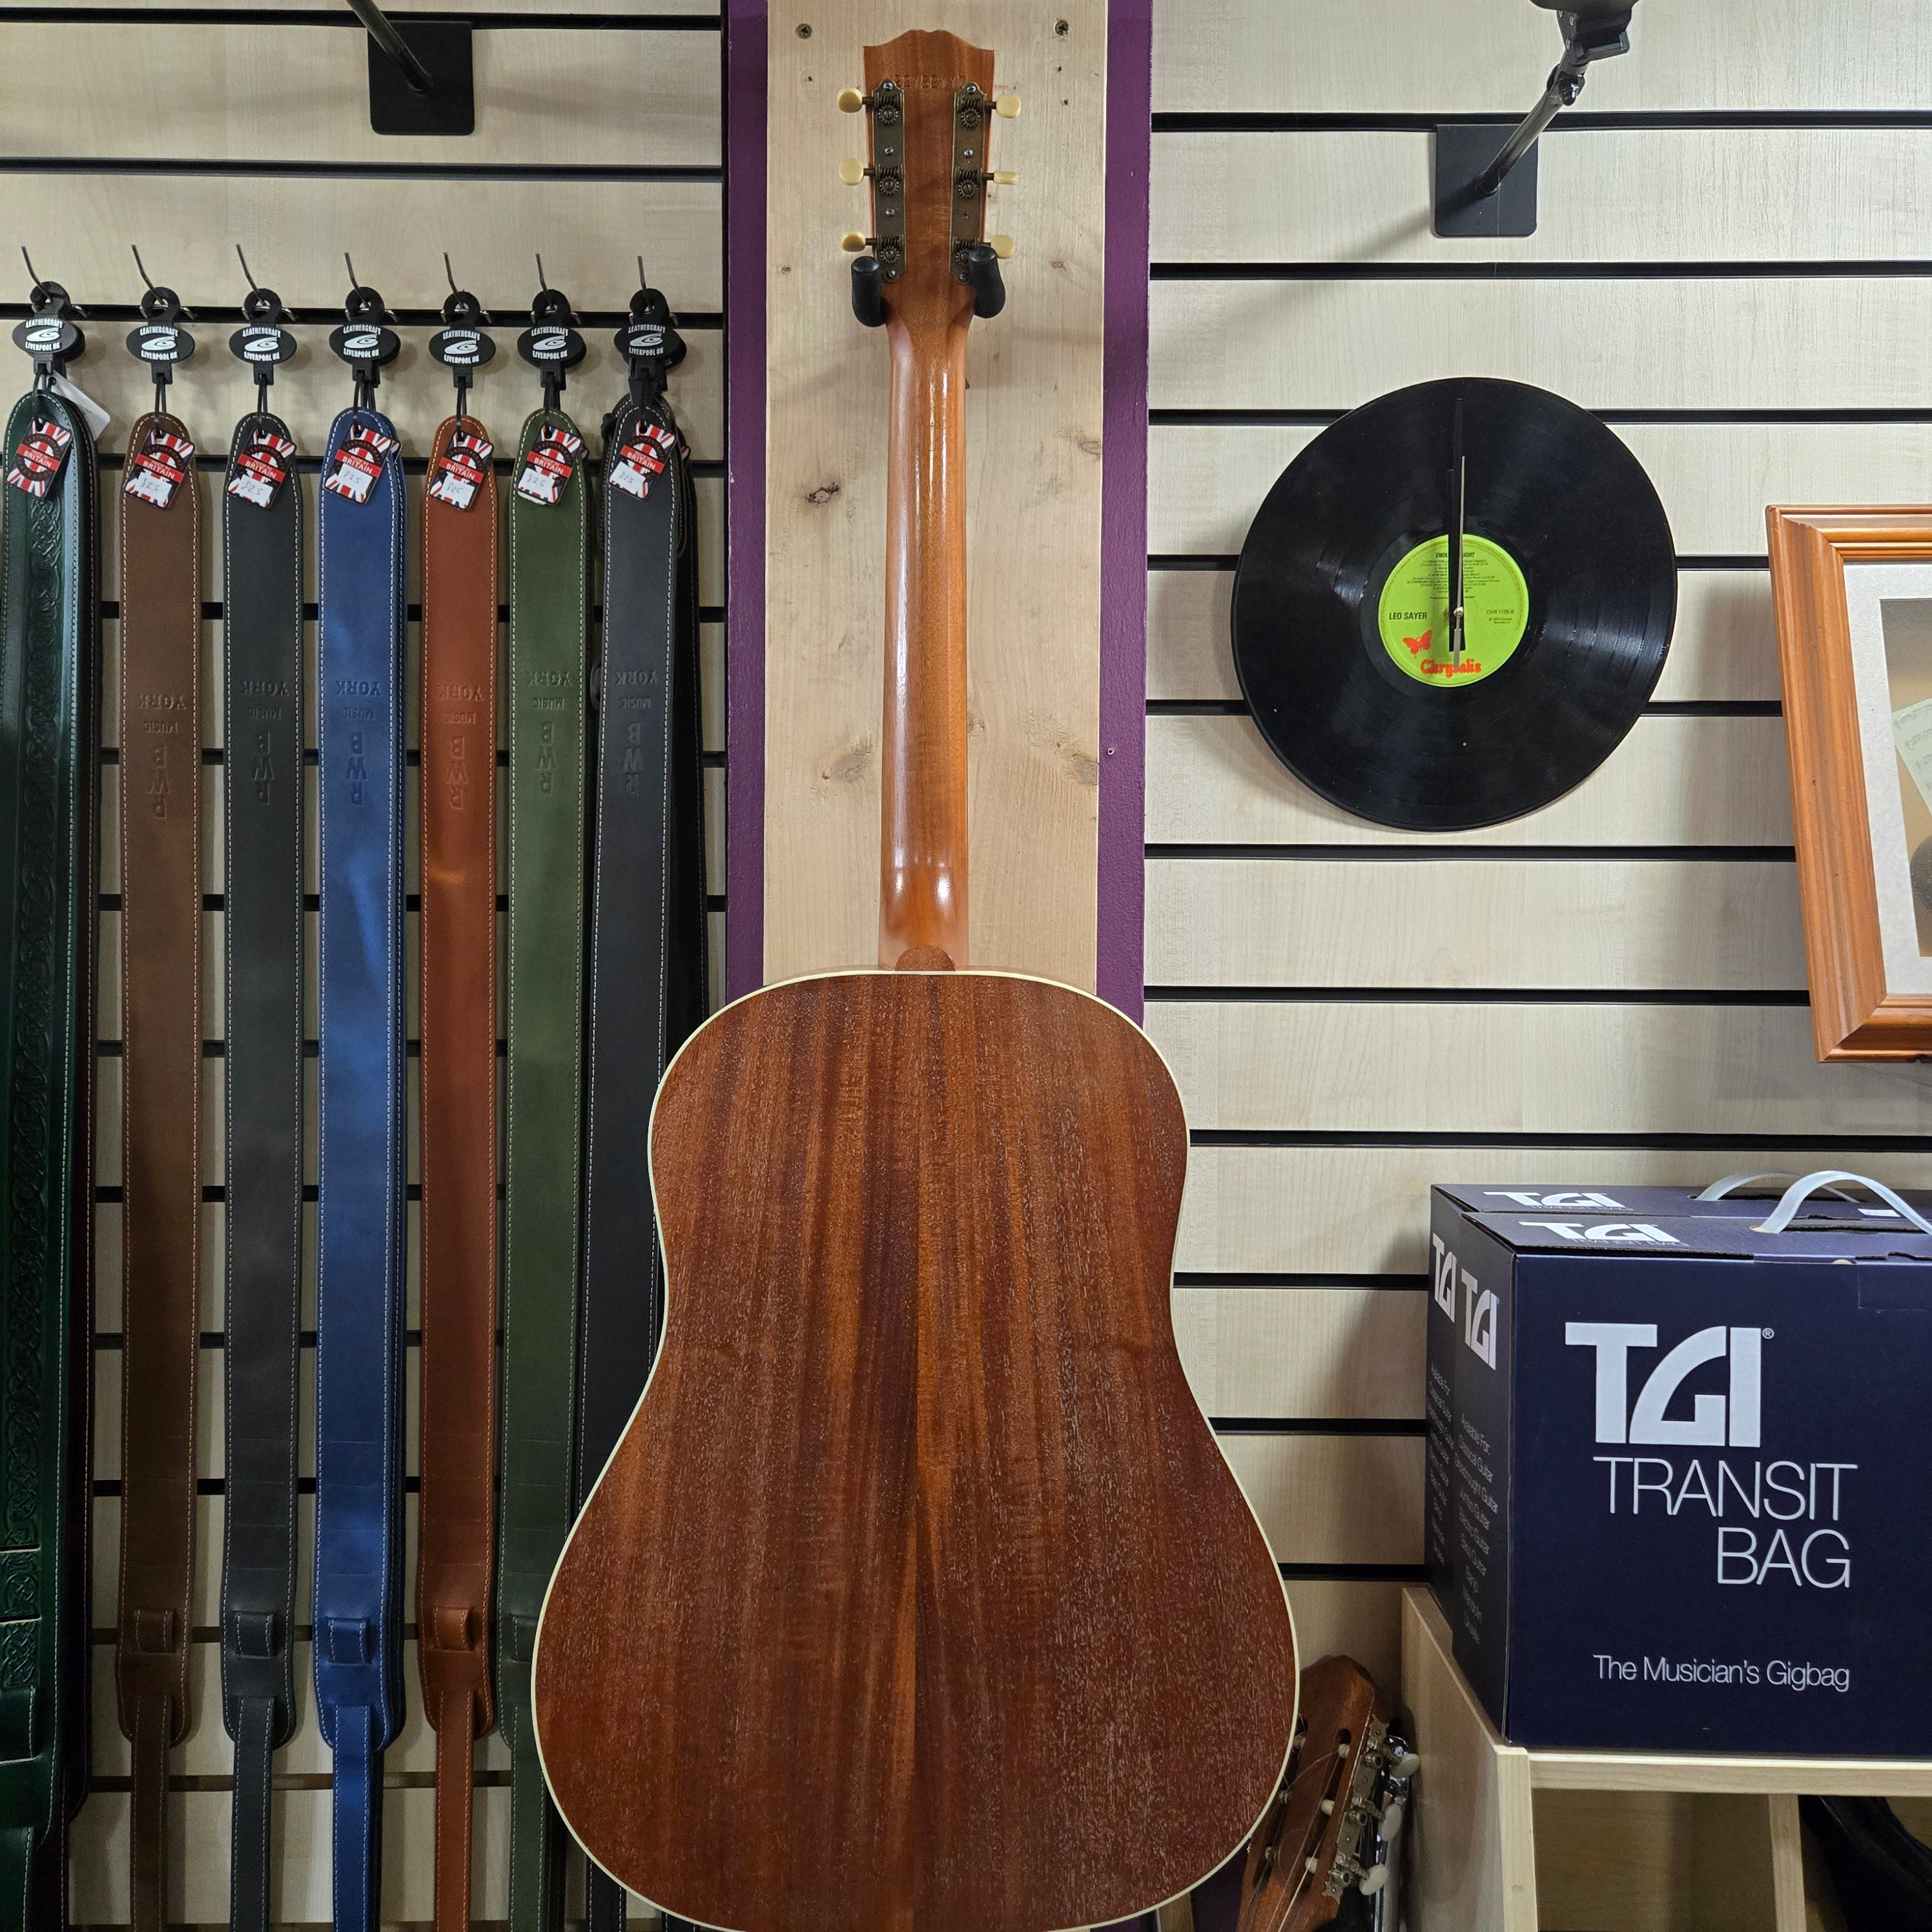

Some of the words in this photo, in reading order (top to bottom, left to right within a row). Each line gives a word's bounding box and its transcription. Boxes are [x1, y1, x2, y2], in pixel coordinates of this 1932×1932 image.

[26, 319, 63, 329] LEATHERCRAFT
[140, 326, 178, 337] LEATHERCRAFT
[343, 324, 381, 335] LEATHERCRAFT
[531, 326, 568, 336] LEATHERCRAFT
[628, 324, 666, 334] LEATHERCRAFT
[243, 327, 281, 338] LEATHERCRAFT
[442, 330, 480, 341] LEATHERCRAFT
[25, 342, 52, 351] LIVERPOOL
[344, 348, 371, 358] LIVERPOOL
[629, 347, 656, 356] LIVERPOOL
[141, 351, 169, 360] LIVERPOOL
[244, 351, 272, 362] LIVERPOOL
[444, 355, 471, 364] LIVERPOOL
[532, 350, 560, 360] LIVERPOOL
[23, 450, 52, 468] BRITAIN
[342, 456, 373, 474] BRITAIN
[533, 457, 564, 475] BRITAIN
[626, 451, 656, 469] BRITAIN
[142, 460, 176, 479] BRITAIN
[245, 460, 277, 478] BRITAIN
[446, 462, 475, 480] BRITAIN
[526, 670, 573, 686] YORK
[615, 670, 659, 686] YORK
[242, 681, 289, 697] YORK
[335, 680, 382, 697] YORK
[436, 685, 484, 702] YORK
[136, 694, 187, 710] YORK
[1483, 1192, 1626, 1208] TGI
[1519, 1222, 1680, 1242] TGI
[1433, 1233, 1457, 1323] TGI
[1461, 1268, 1497, 1370] TGI
[1565, 1322, 1762, 1447] TGI
[1593, 1457, 1858, 1521] TRANSIT
[1717, 1527, 1851, 1588] BAG
[1593, 1655, 1636, 1680] The
[1643, 1656, 1760, 1684] Musician's
[1767, 1661, 1849, 1692] Gigbag
